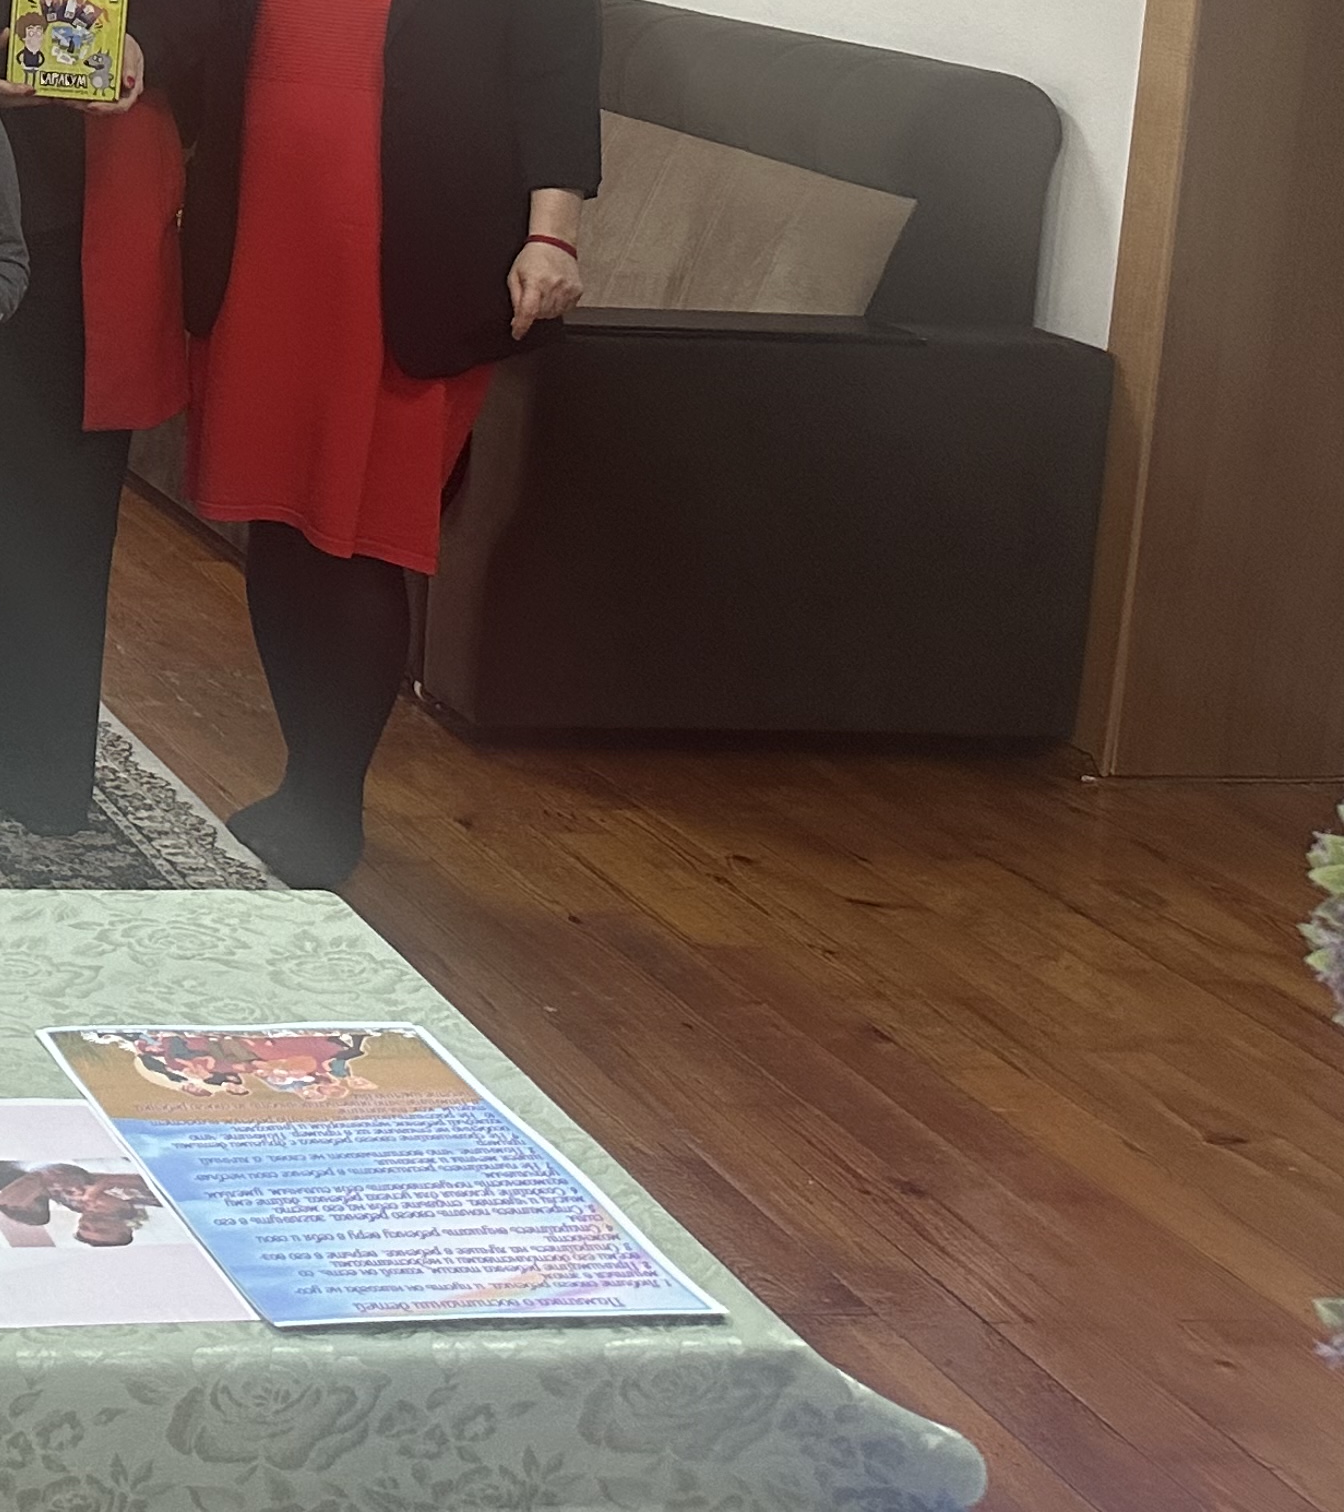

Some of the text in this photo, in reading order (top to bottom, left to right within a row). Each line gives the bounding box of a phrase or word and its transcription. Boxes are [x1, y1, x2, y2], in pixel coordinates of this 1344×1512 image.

[356, 1301, 411, 1313] детей
[414, 1298, 519, 1309] воспитании
[541, 1297, 622, 1309] Памятка
